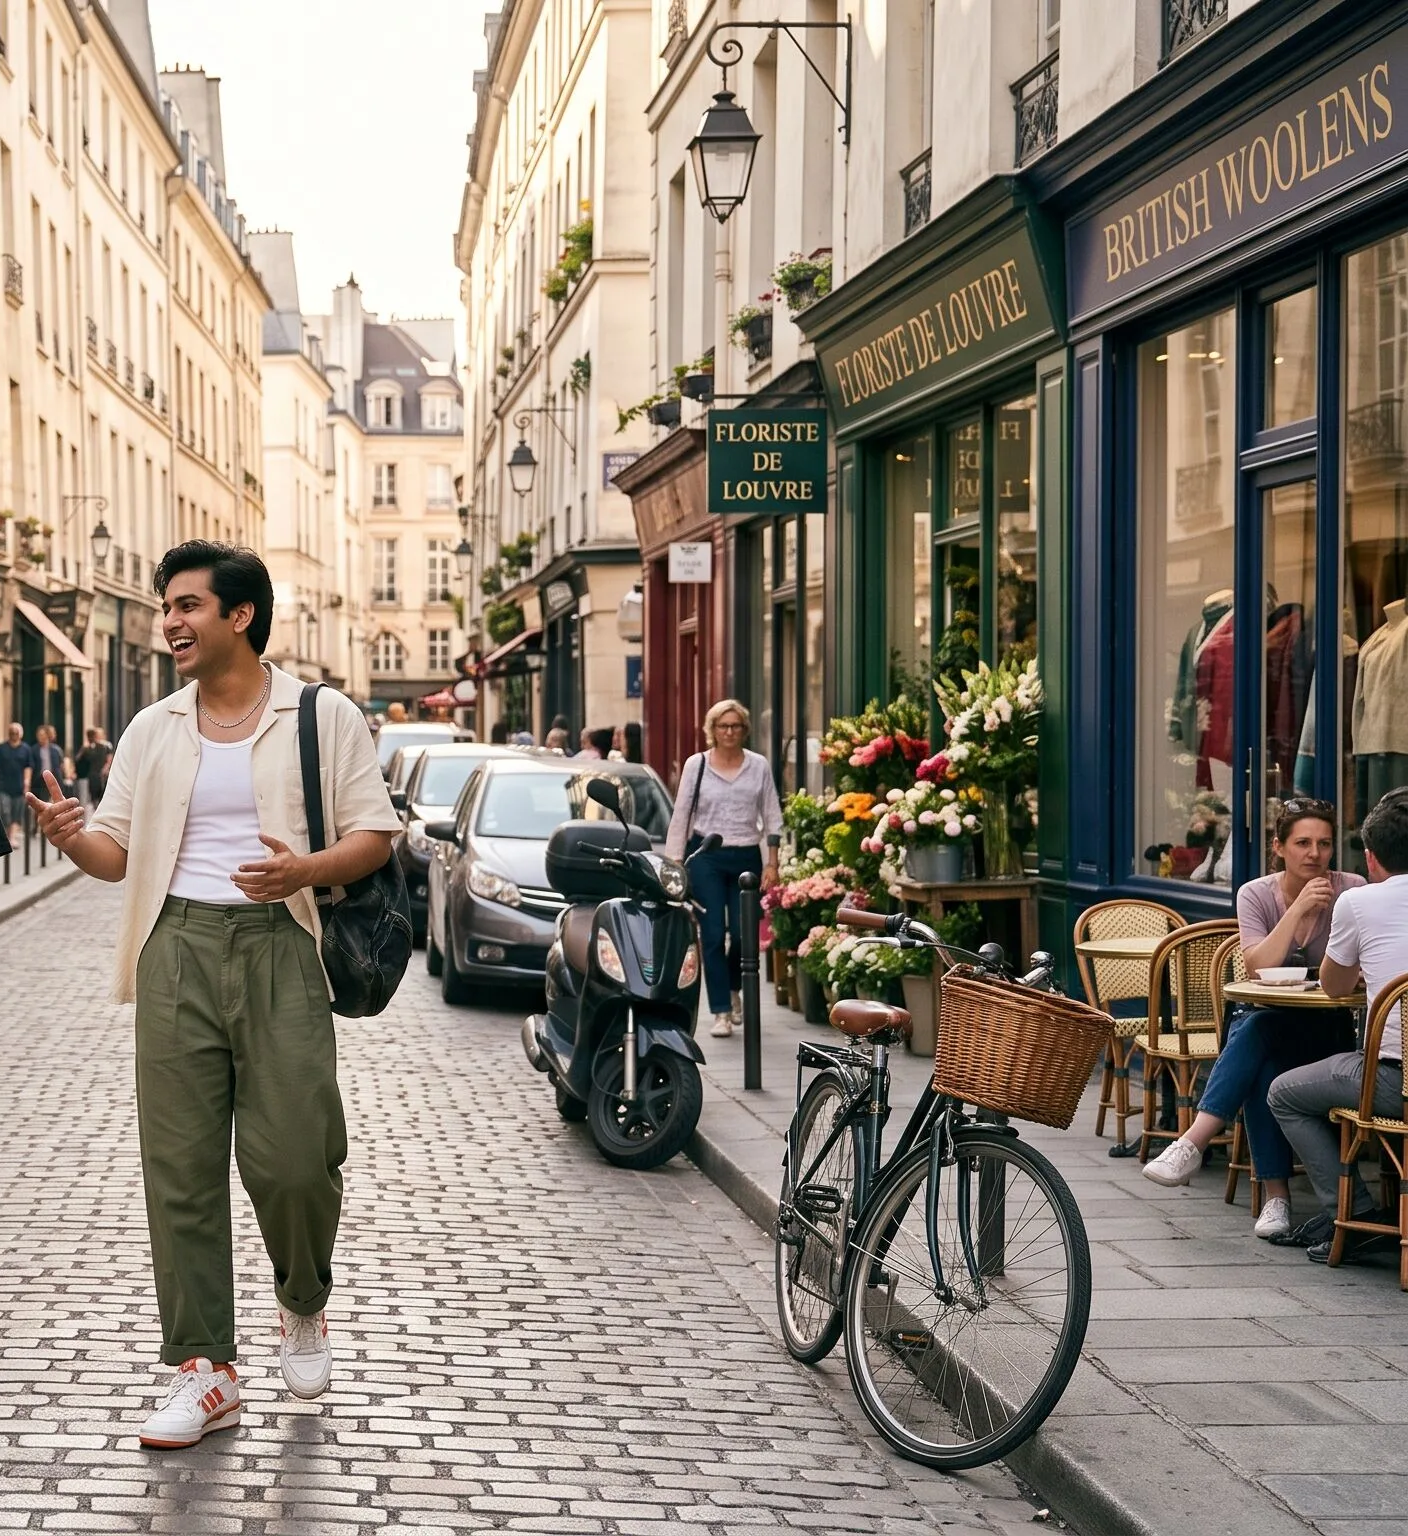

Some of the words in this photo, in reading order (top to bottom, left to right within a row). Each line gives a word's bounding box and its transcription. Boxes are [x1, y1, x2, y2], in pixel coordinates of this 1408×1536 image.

[1103, 167, 1213, 282] BRITISH
[1216, 61, 1393, 221] WOOLENS
[835, 325, 914, 408] FLORISTE
[907, 309, 941, 370] DE
[935, 259, 1028, 356] LOUVRE
[715, 422, 820, 442] FLORISTE
[753, 452, 783, 471] DE
[722, 481, 813, 500] LOUVRE
